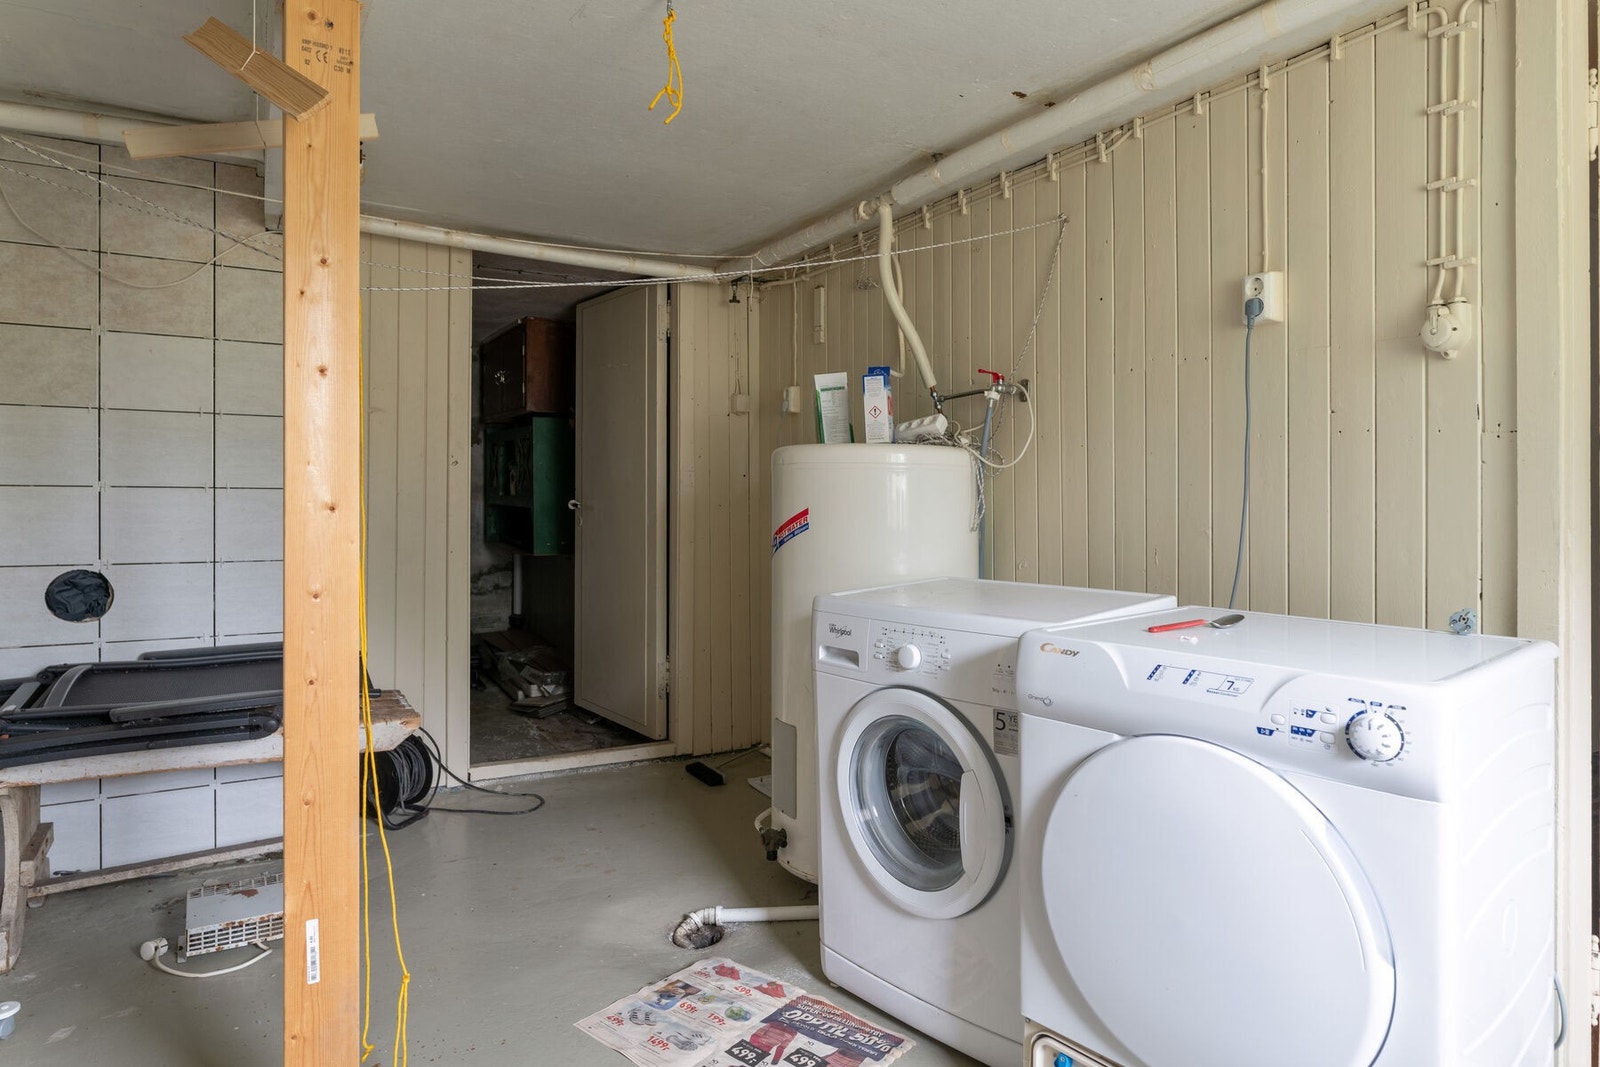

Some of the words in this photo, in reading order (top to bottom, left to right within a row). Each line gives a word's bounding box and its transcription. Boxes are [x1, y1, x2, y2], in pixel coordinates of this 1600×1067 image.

[778, 516, 808, 540] HOTWATER
[829, 623, 852, 639] Whirlpool
[1040, 642, 1080, 657] CANDY
[1227, 680, 1235, 690] 7
[995, 711, 1006, 730] 5
[783, 1008, 846, 1038] OPPTIL
[848, 1032, 892, 1052] 50%
